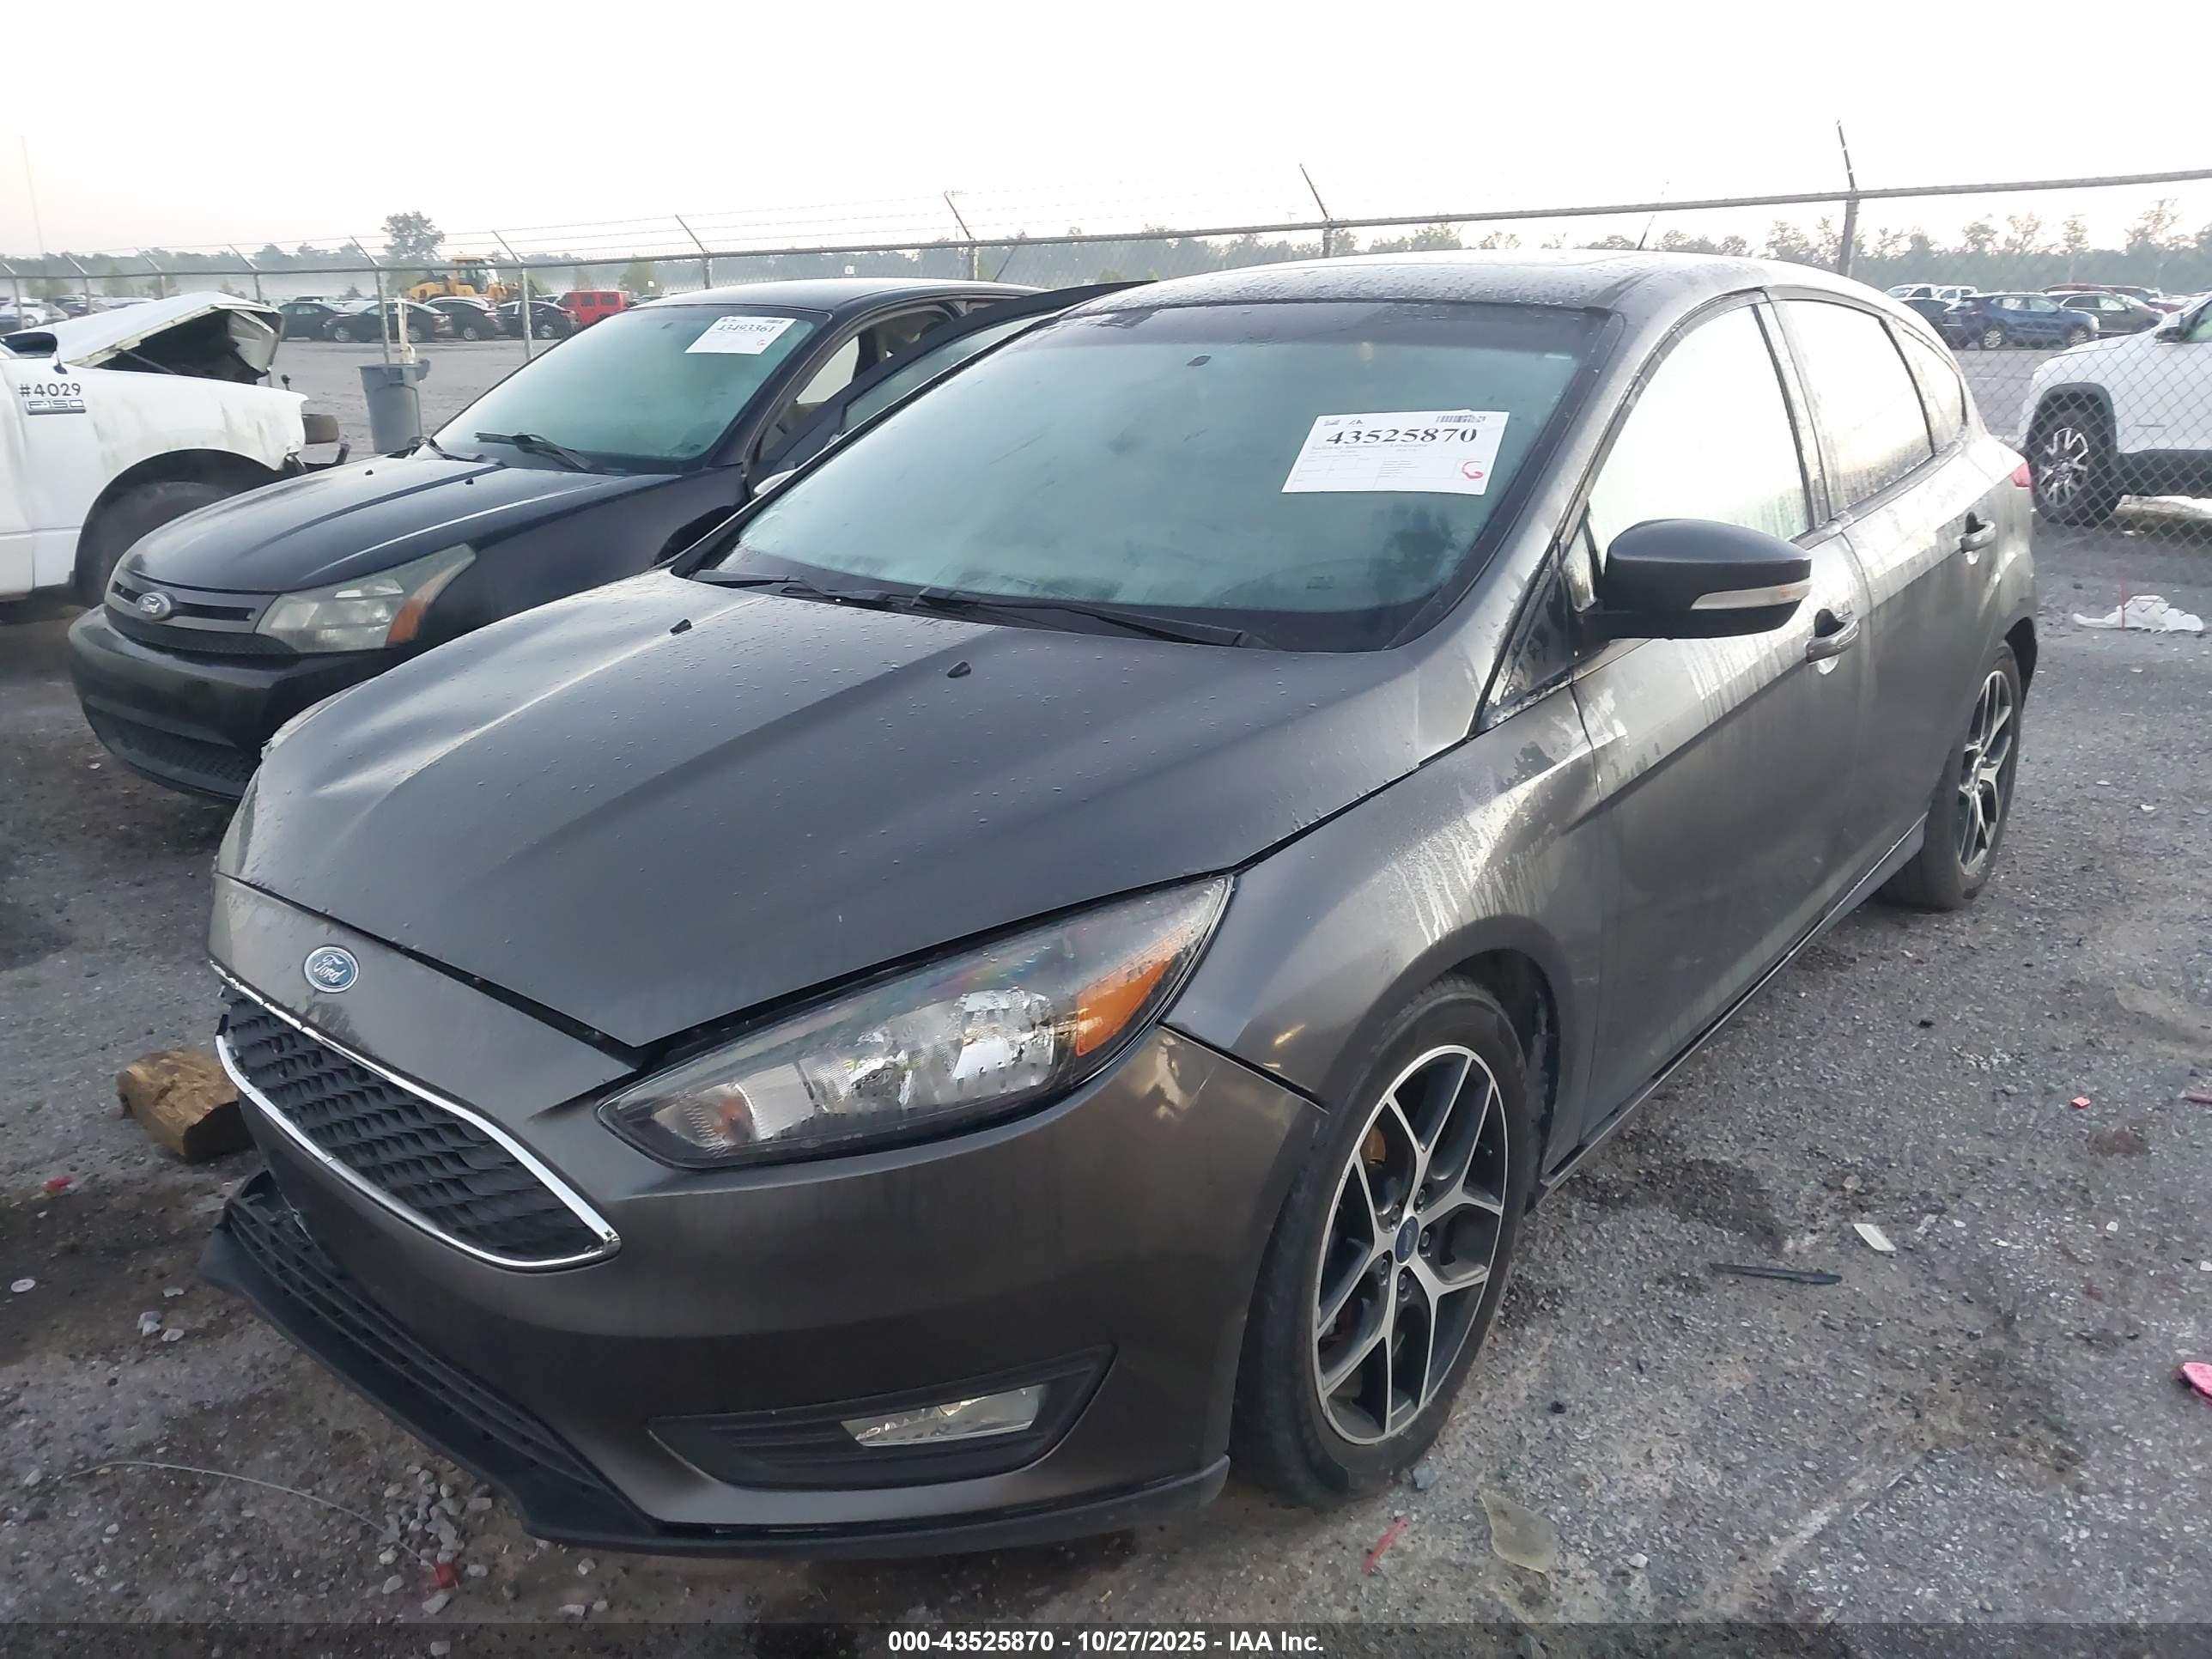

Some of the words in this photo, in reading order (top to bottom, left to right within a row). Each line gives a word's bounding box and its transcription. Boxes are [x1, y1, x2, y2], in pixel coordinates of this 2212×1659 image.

[19, 383, 81, 397] #4029
[29, 399, 84, 410] F-150
[1326, 428, 1477, 445] 43525870
[313, 954, 347, 983] Ford
